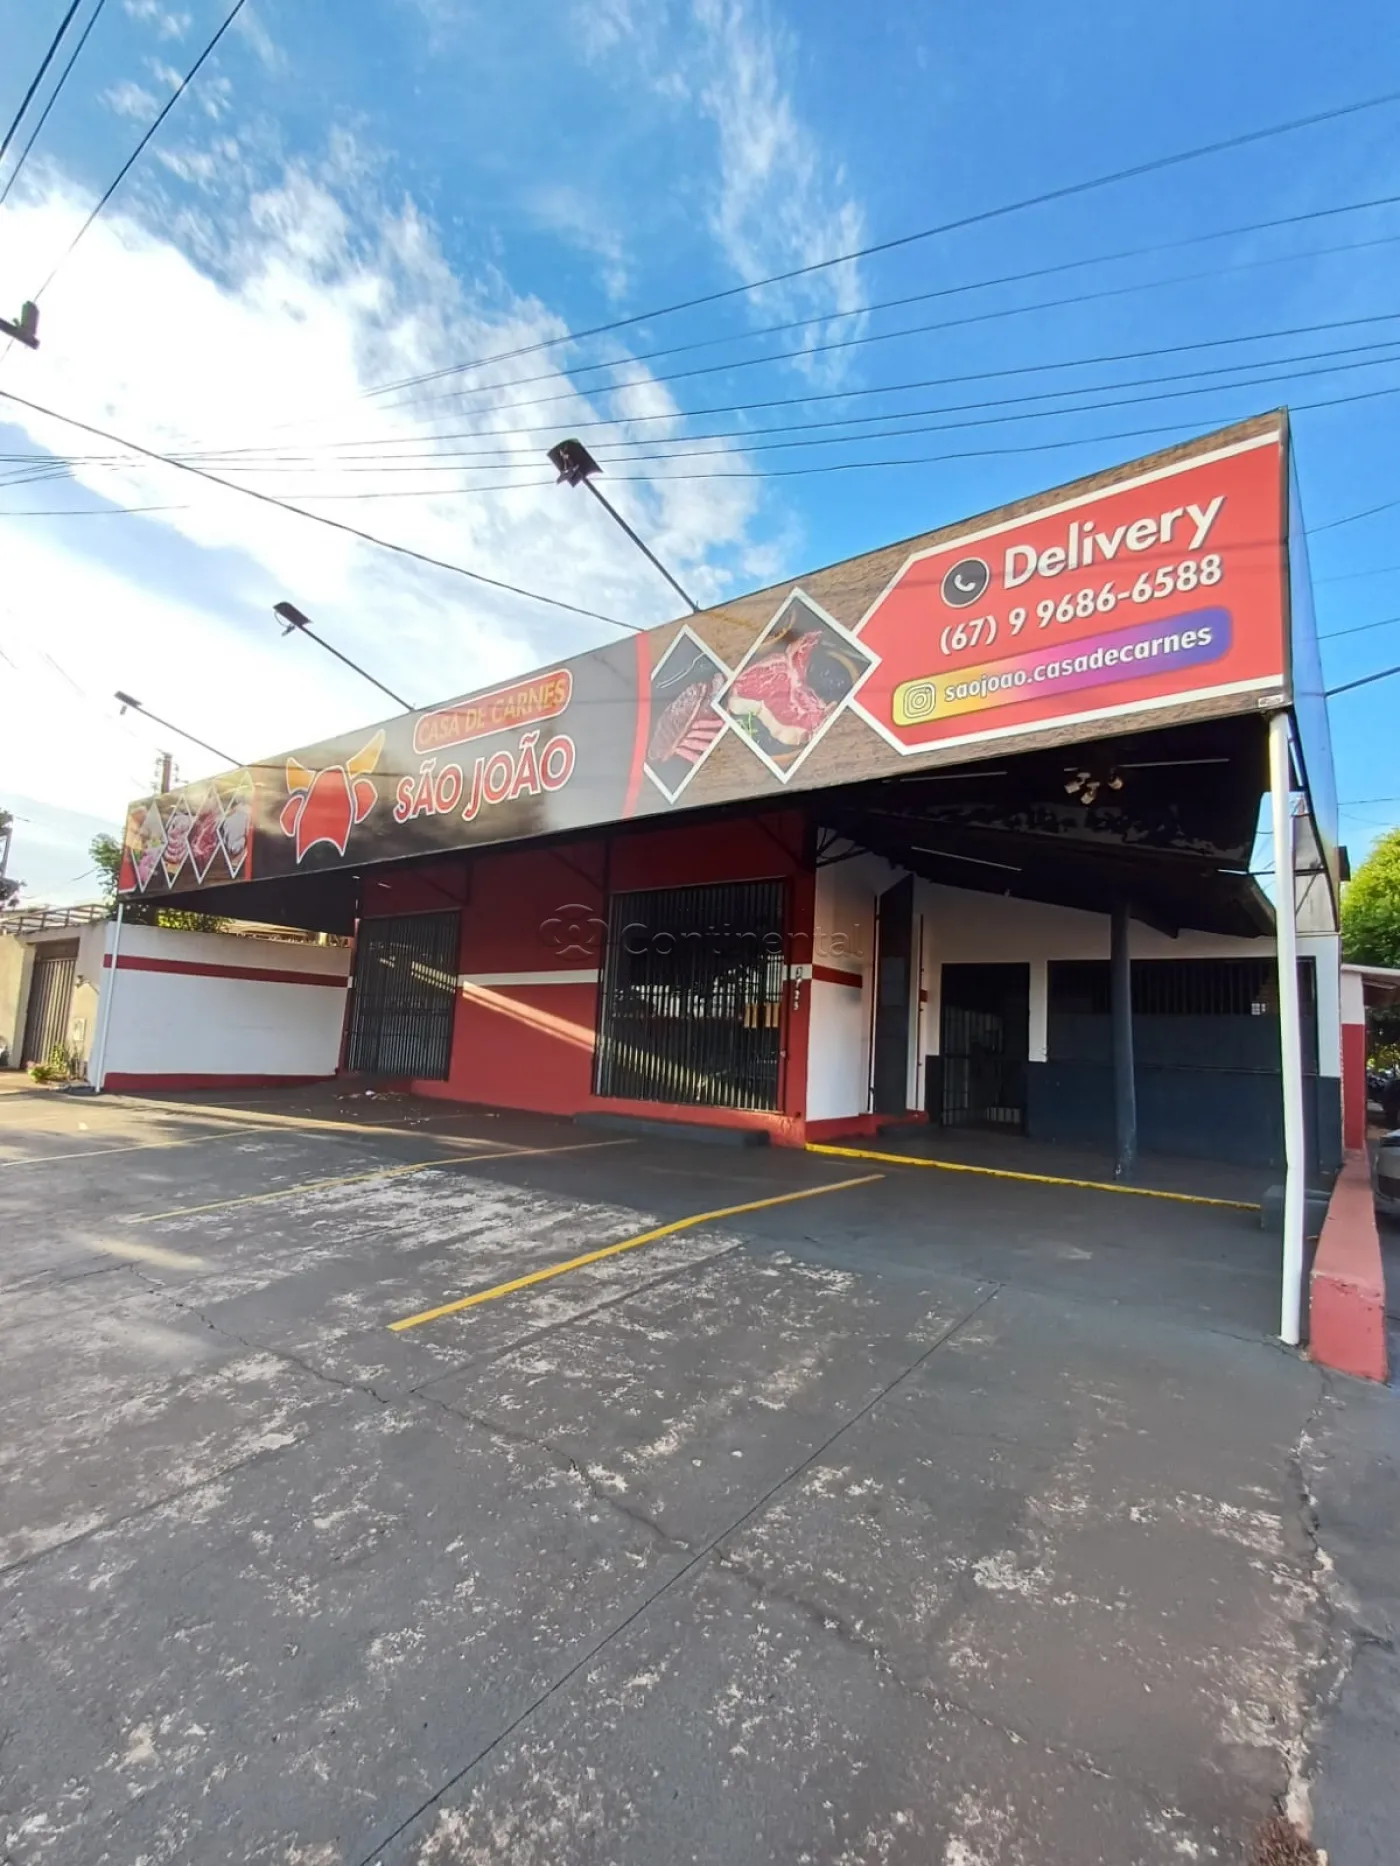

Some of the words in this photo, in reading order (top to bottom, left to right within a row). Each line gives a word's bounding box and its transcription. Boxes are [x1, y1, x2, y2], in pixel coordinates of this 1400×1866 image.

[1004, 496, 1225, 589] Delivery
[941, 615, 997, 655] (67)
[1008, 608, 1027, 636] 9
[1036, 554, 1222, 629] 9686-6588
[944, 625, 1212, 702] saojoao.casadecarnes
[420, 716, 462, 745] CASA
[465, 707, 485, 730] DE
[492, 679, 566, 722] CARNES
[393, 757, 463, 823] SÃO
[461, 730, 576, 821] JOÃO
